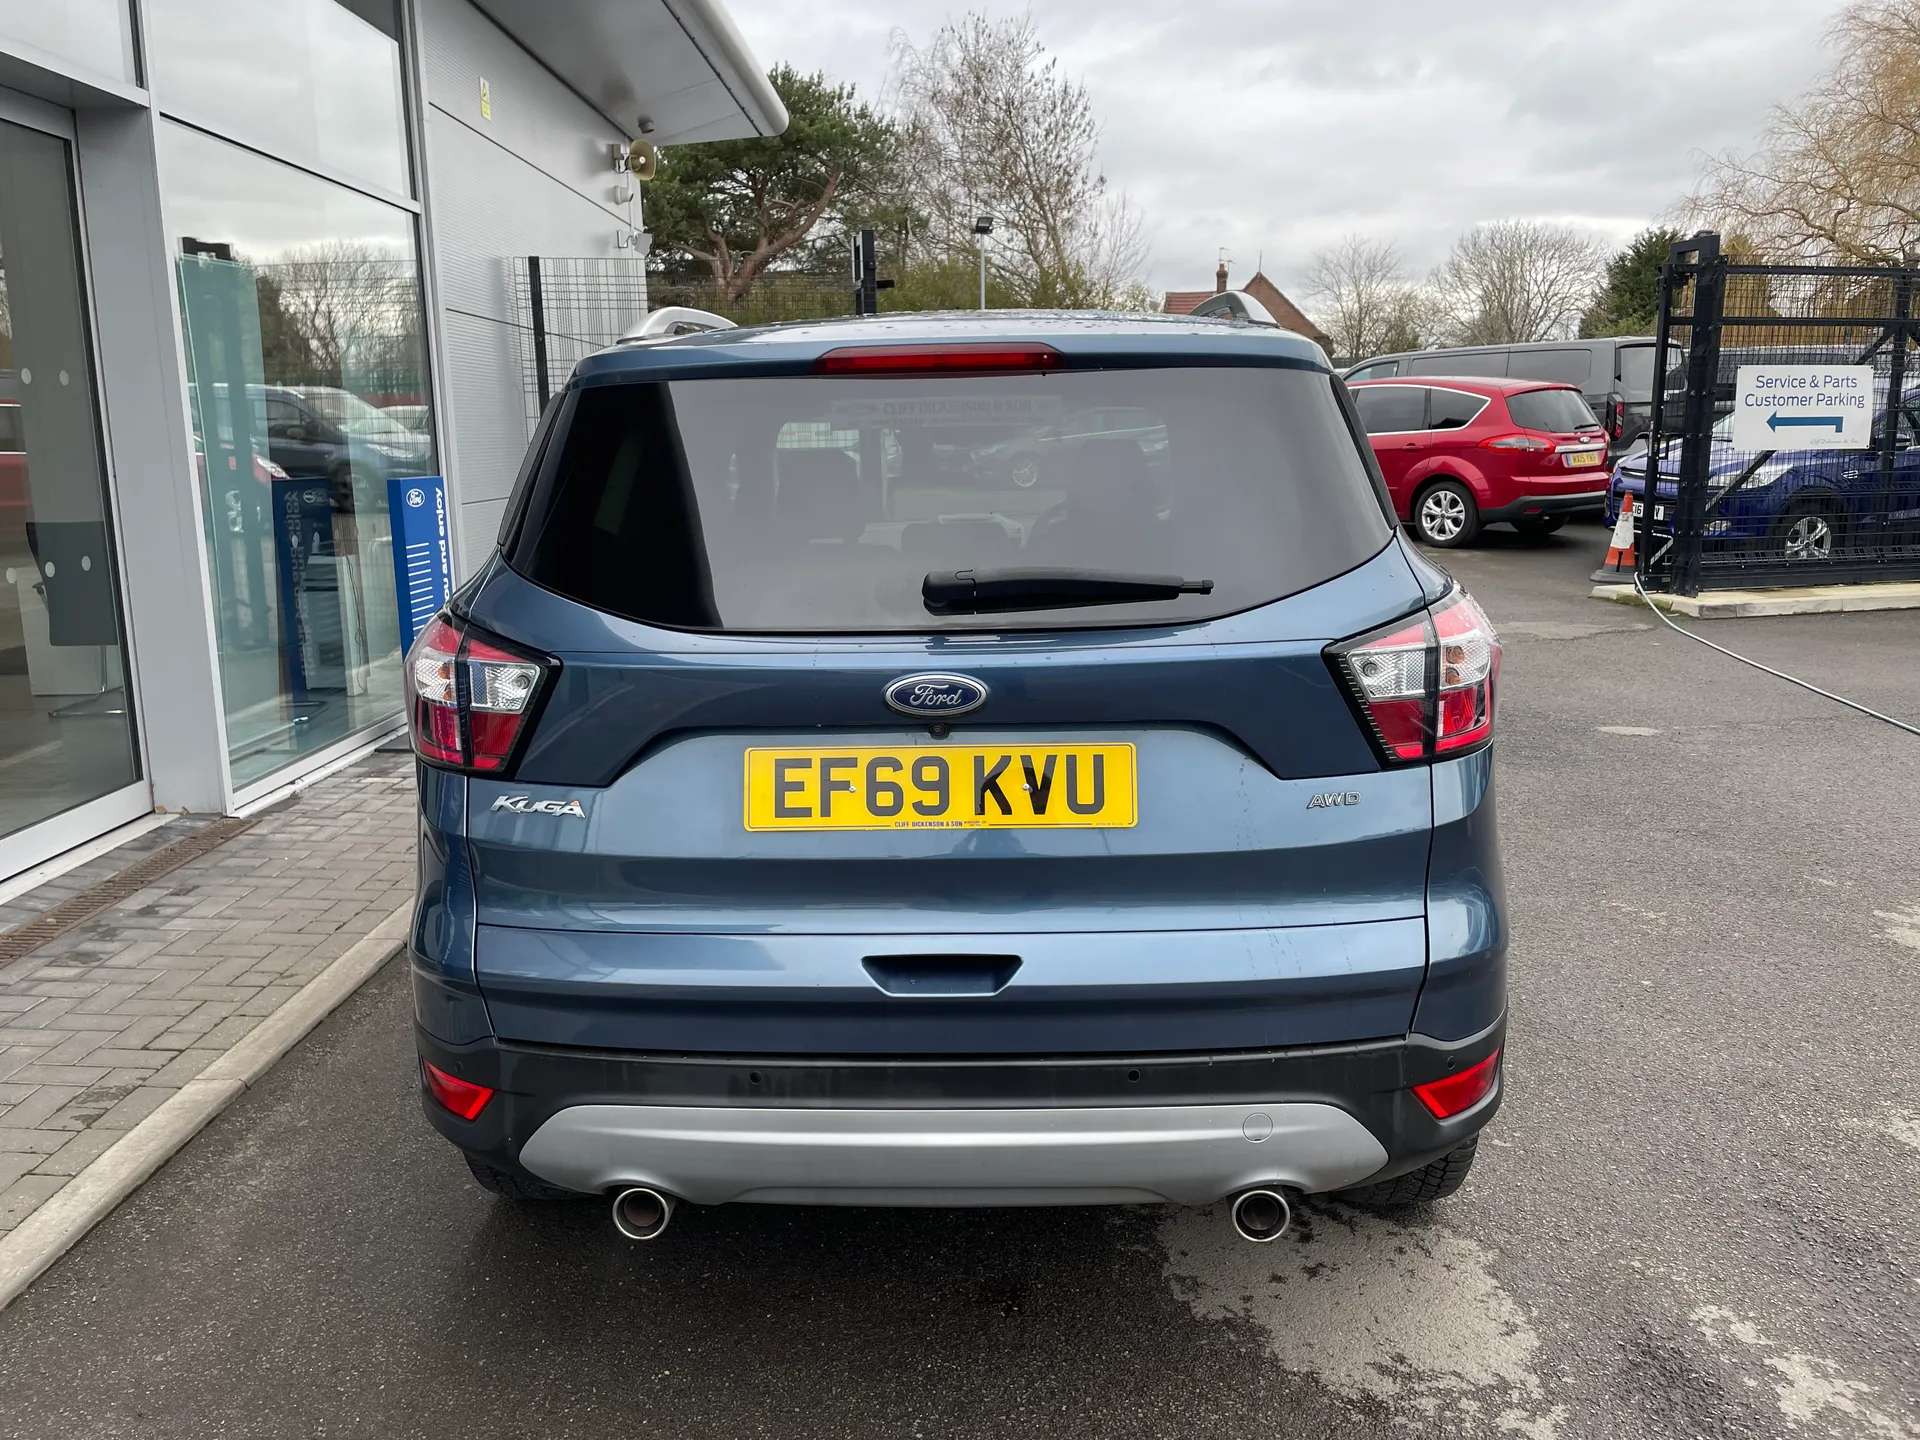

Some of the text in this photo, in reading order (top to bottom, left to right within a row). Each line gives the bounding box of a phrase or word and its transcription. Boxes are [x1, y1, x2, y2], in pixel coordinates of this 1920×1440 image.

[1755, 375, 1857, 388] Service & Parts
[1745, 393, 1865, 408] Customer Parking
[435, 487, 445, 537] enjoy
[438, 539, 448, 575] and
[909, 684, 963, 706] Ford
[774, 754, 1105, 818] EF69 KVU
[489, 795, 586, 818] KUGA
[1306, 791, 1361, 809] AWD
